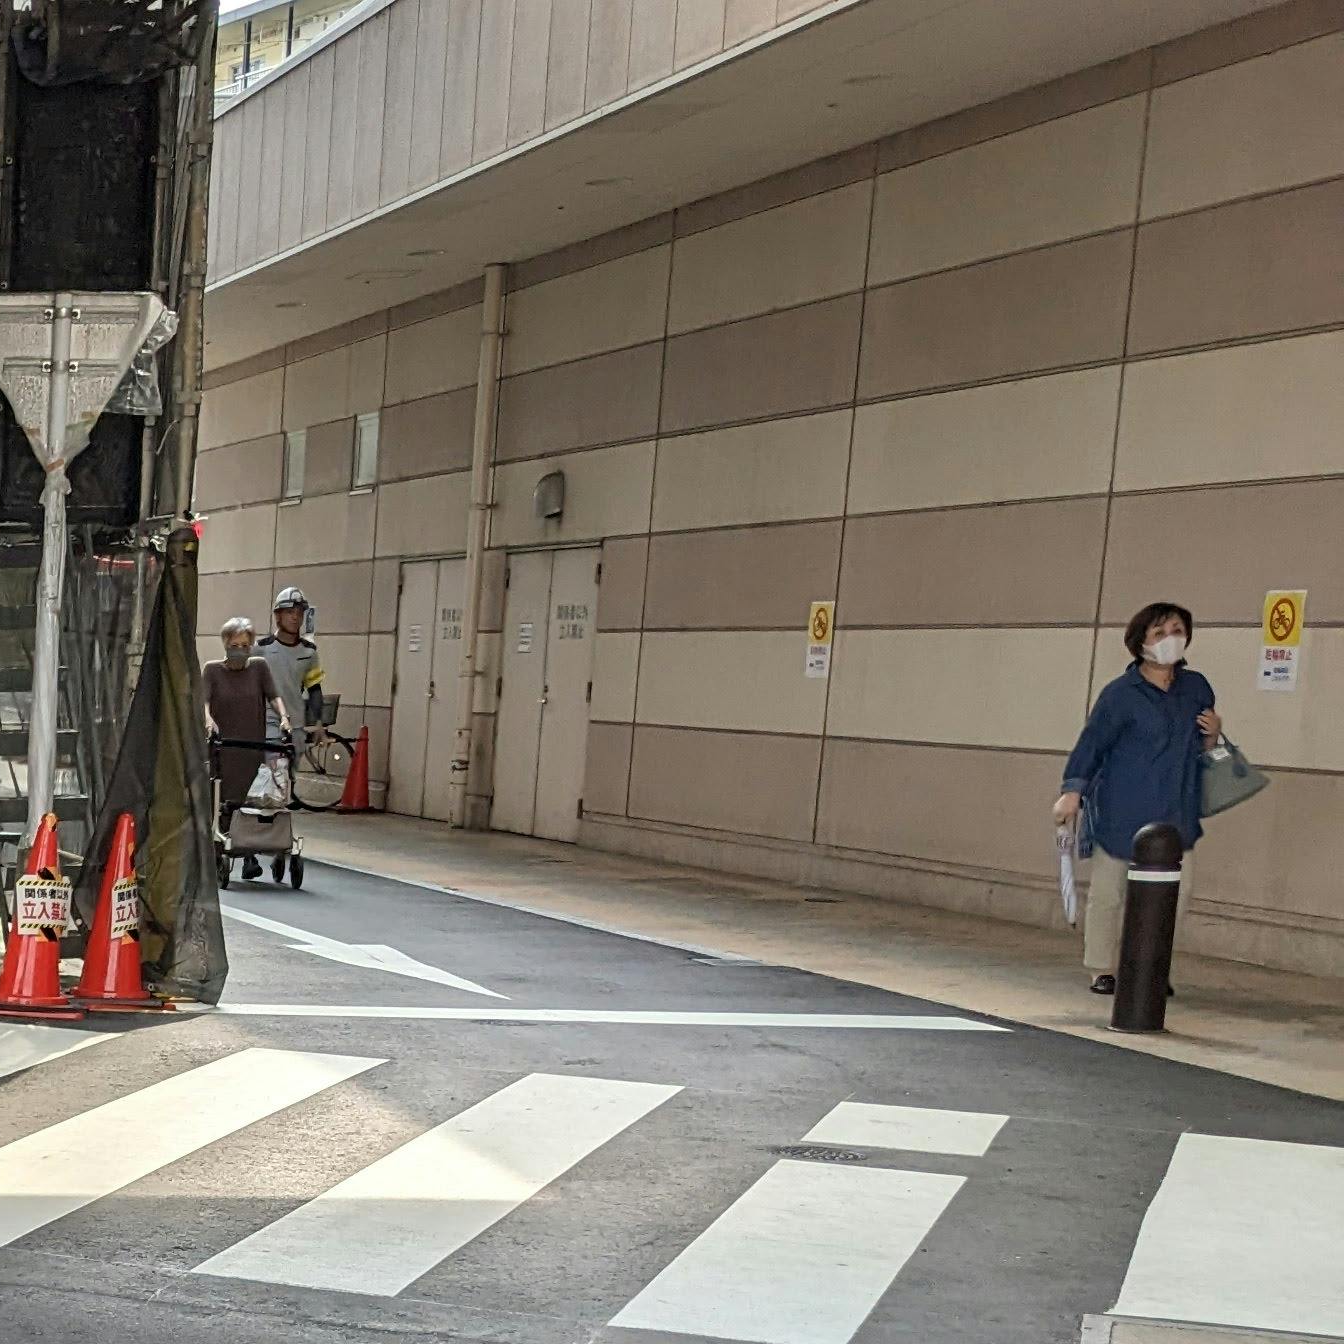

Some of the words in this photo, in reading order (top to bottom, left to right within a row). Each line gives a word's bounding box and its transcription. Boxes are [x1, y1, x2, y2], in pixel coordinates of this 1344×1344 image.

[24, 888, 69, 900] 関係者以外
[22, 900, 67, 921] 立入禁止
